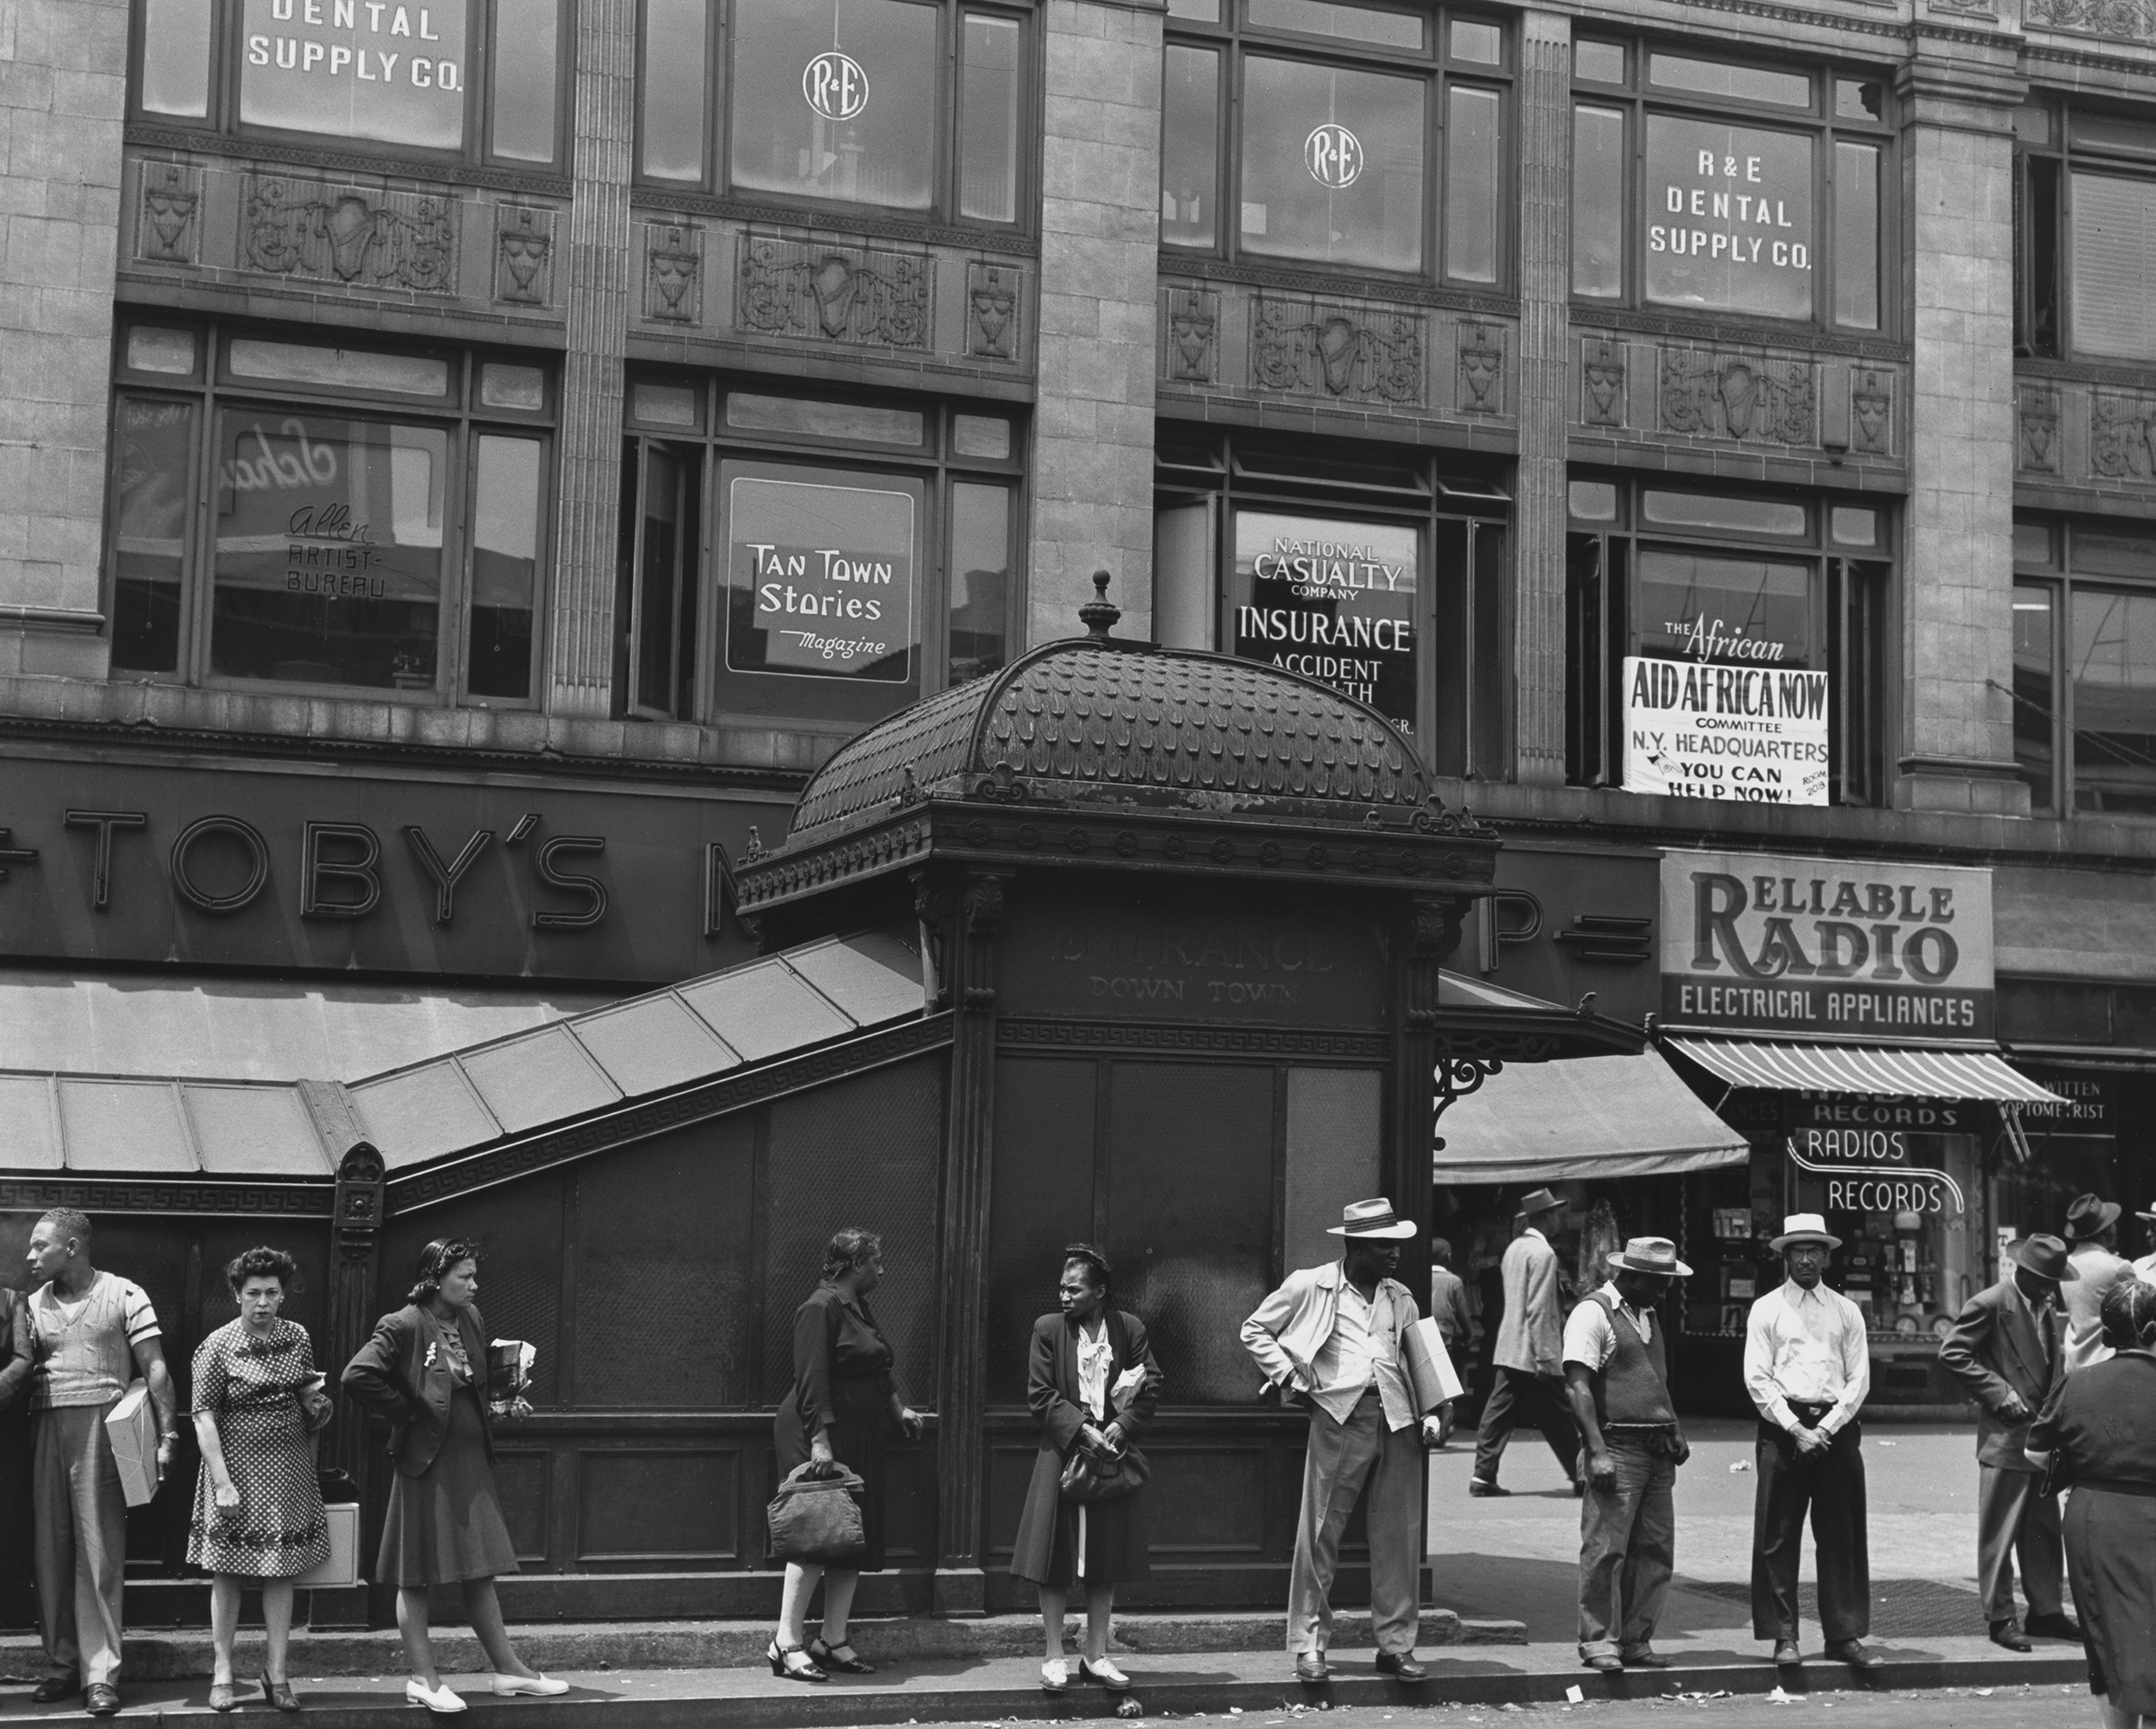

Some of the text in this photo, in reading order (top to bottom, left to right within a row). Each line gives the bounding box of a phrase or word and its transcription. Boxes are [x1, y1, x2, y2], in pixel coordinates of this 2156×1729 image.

[272, 0, 438, 41] DENTAL
[248, 34, 463, 91] SUPPLY CO.
[1667, 186, 1792, 228] DENTAL
[1650, 226, 1812, 270] SUPPLY CO.
[1274, 537, 1380, 562] NATIONAL
[287, 572, 385, 599] BUREAU
[1254, 553, 1403, 592] CASUALTY
[759, 584, 881, 620] Stories
[1291, 584, 1359, 601] COMPANY
[780, 630, 886, 659] Magazine
[1240, 606, 1410, 652] INSURANCE
[1665, 611, 1785, 663] THE African
[1272, 653, 1382, 680] ACCIDENT
[1632, 661, 1827, 721] AID AFRICA NOW
[1696, 718, 1782, 734] COMMITTEE
[1632, 731, 1828, 763] N.Y. HEADQUARTERS
[1681, 763, 1781, 783] YOU CAN
[1803, 770, 1826, 785] ROOM
[1735, 786, 1791, 803] NOW!
[63, 808, 608, 929] TOBY'S
[1690, 901, 1959, 984] RADIO
[1089, 976, 1300, 1005] DOWN TOWN
[1681, 985, 1974, 1027] ELECTRICAL APPLIANCES
[2044, 1080, 2100, 1097] WITTEN
[1814, 1104, 1958, 1126] RECORDS
[1808, 1129, 1904, 1160] RADIOS
[1829, 1180, 1941, 1212] RECORDS
